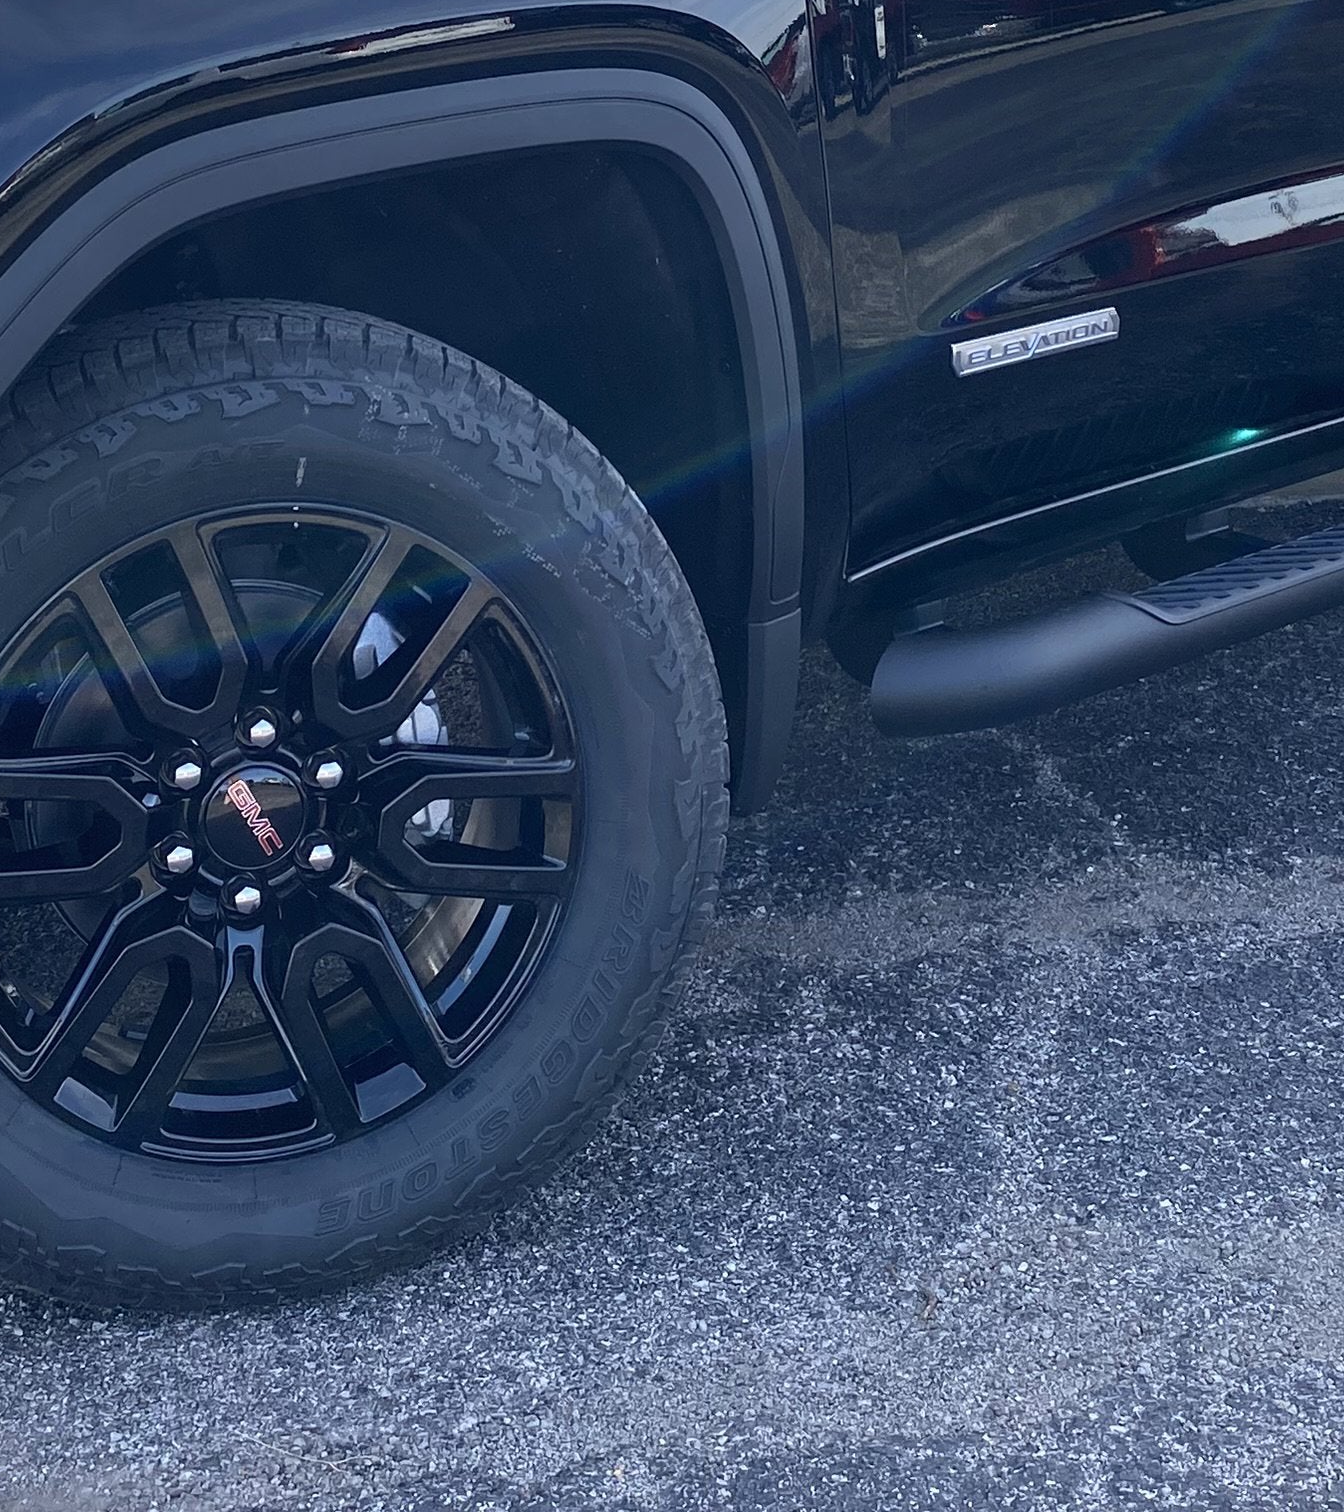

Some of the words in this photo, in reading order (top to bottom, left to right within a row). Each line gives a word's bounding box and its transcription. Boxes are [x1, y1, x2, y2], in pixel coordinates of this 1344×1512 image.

[968, 320, 1109, 365] ELEVATION
[227, 779, 284, 857] GMC
[315, 866, 653, 1237] BRIDGESTONE
